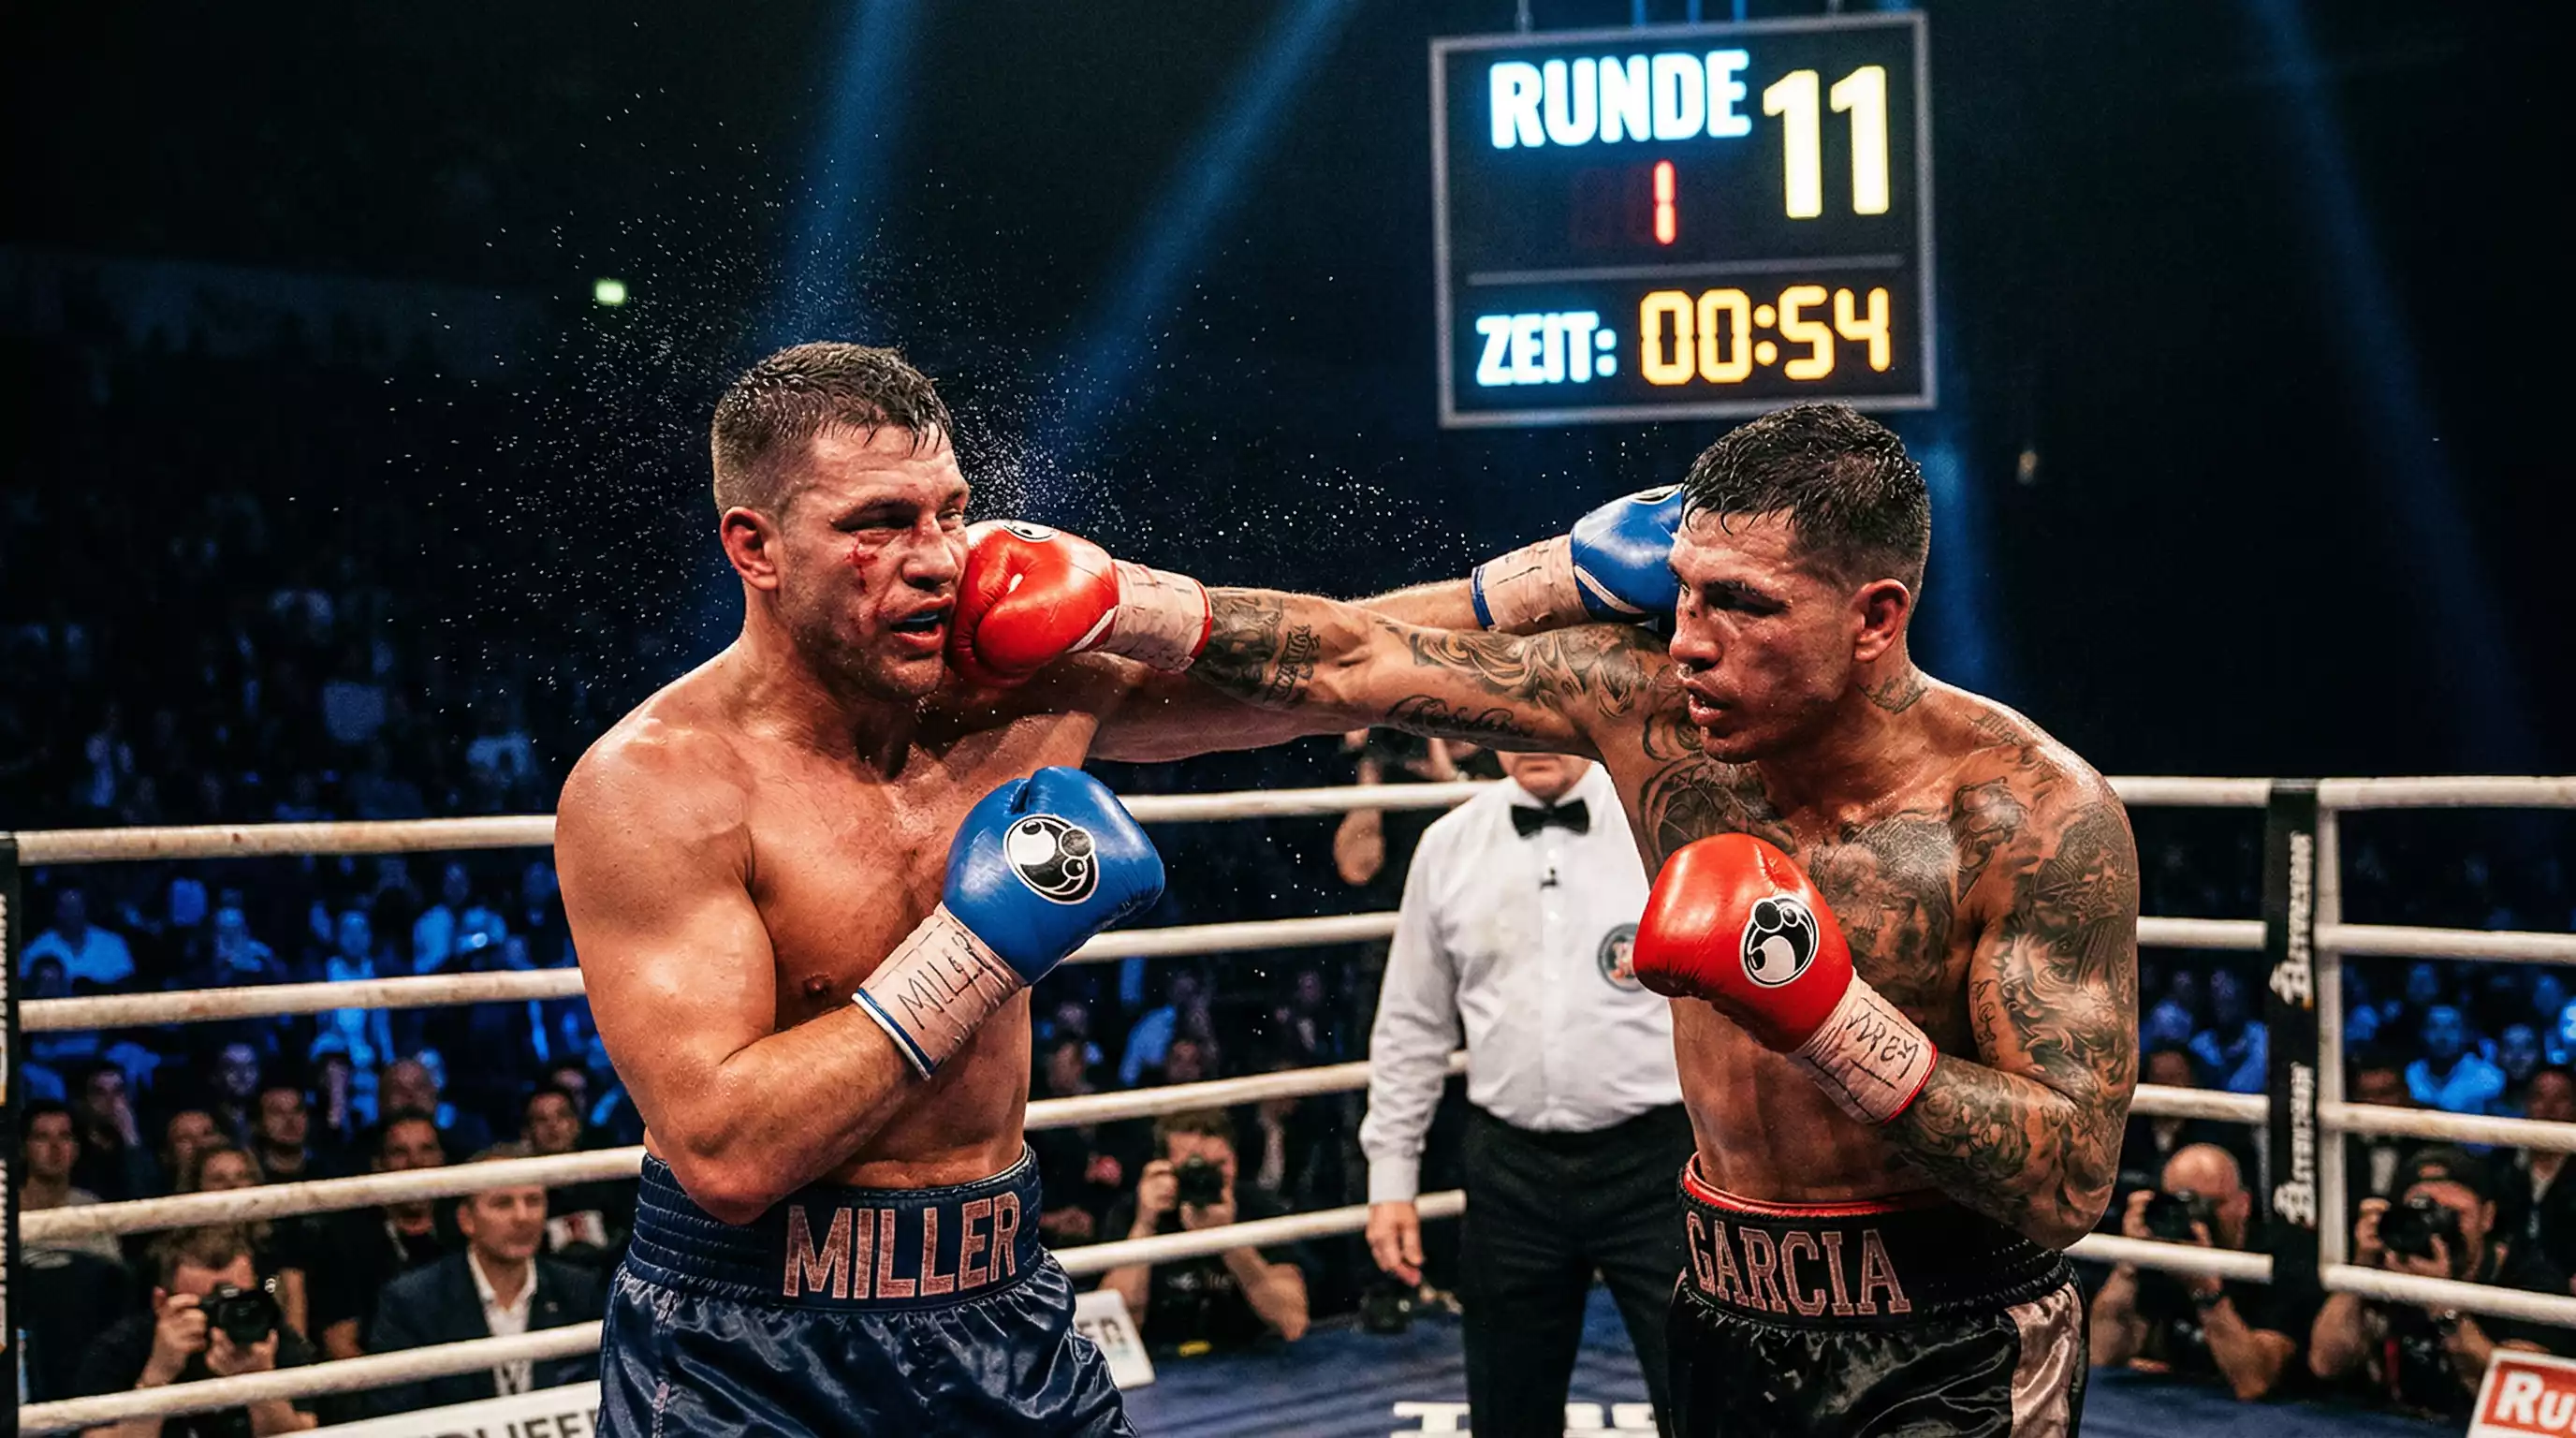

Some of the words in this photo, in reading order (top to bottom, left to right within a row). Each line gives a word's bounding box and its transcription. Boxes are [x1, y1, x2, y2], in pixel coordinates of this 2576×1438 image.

[1489, 49, 1752, 149] RUNDE
[1763, 66, 1890, 219] 11
[1475, 311, 1617, 387] ZEIT:
[1639, 285, 1892, 386] 00:54
[783, 1191, 1021, 1299] MILLER
[1686, 1210, 1911, 1317] GARCIA
[2494, 1370, 2576, 1435] Ru
